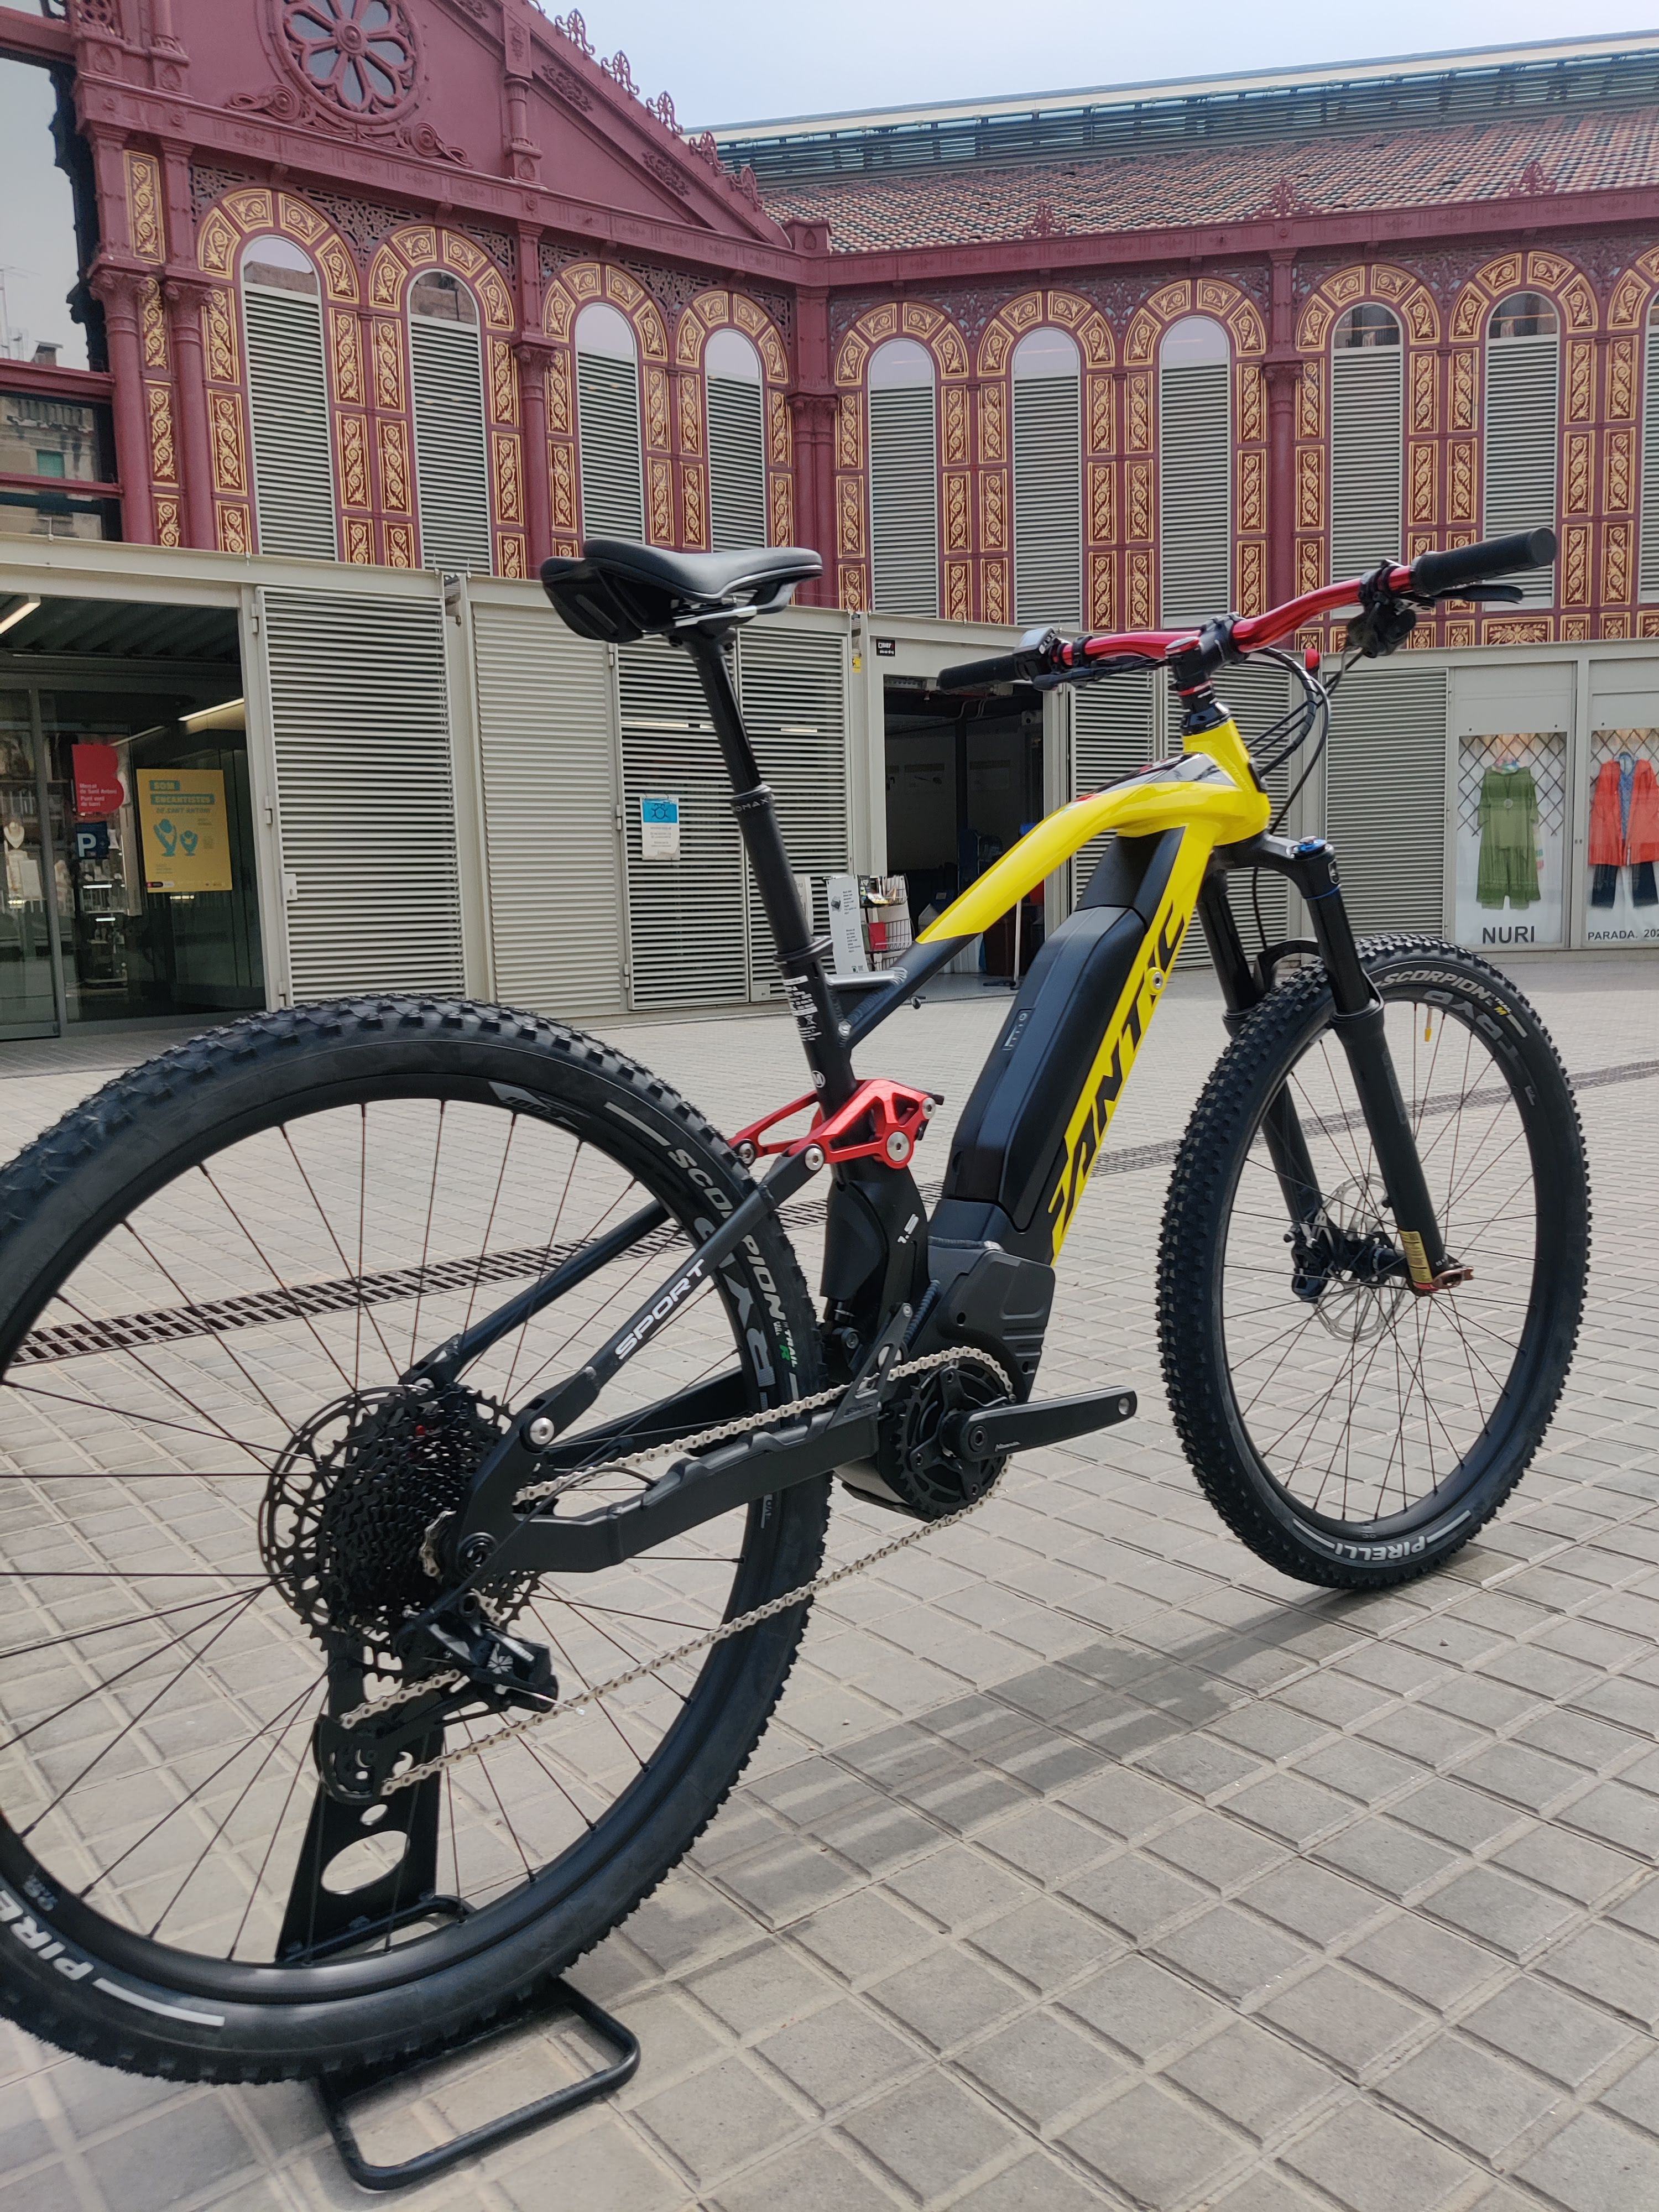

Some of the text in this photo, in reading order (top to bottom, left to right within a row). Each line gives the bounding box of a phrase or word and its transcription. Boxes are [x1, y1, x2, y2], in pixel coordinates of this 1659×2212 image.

[77, 833, 97, 858] P
[1482, 925, 1535, 944] NURI
[1383, 970, 1491, 1000] SCORPION
[667, 1149, 786, 1321] SCOPION
[614, 1259, 705, 1360] SPORT
[784, 1329, 797, 1368] TRAIL
[1334, 1536, 1427, 1562] PIRELLI
